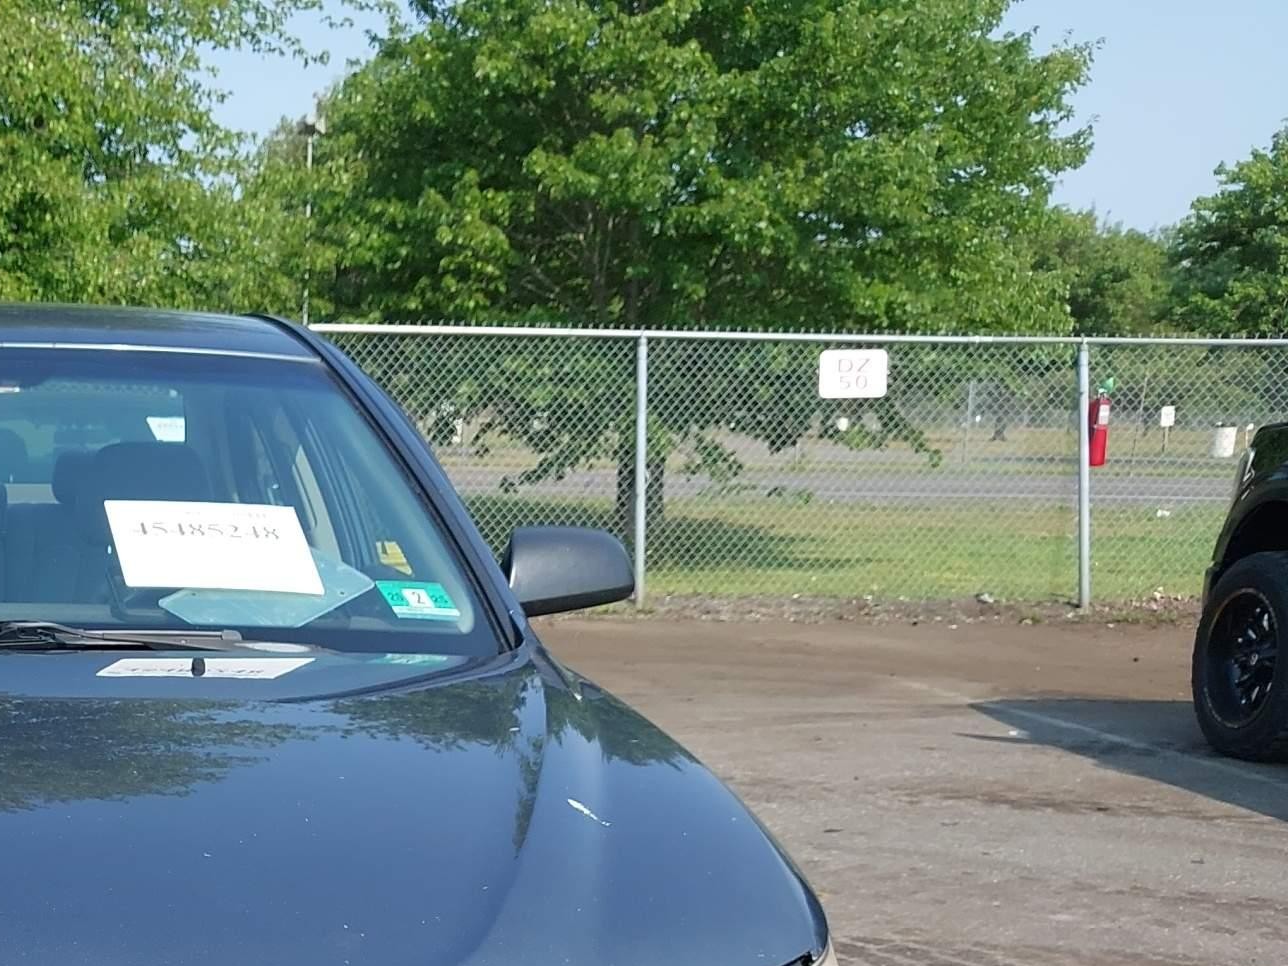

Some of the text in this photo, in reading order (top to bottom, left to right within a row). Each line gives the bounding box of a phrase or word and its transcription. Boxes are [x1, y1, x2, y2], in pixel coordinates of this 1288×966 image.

[838, 358, 871, 373] DZ
[839, 375, 868, 390] 50
[133, 521, 281, 541] 45485248
